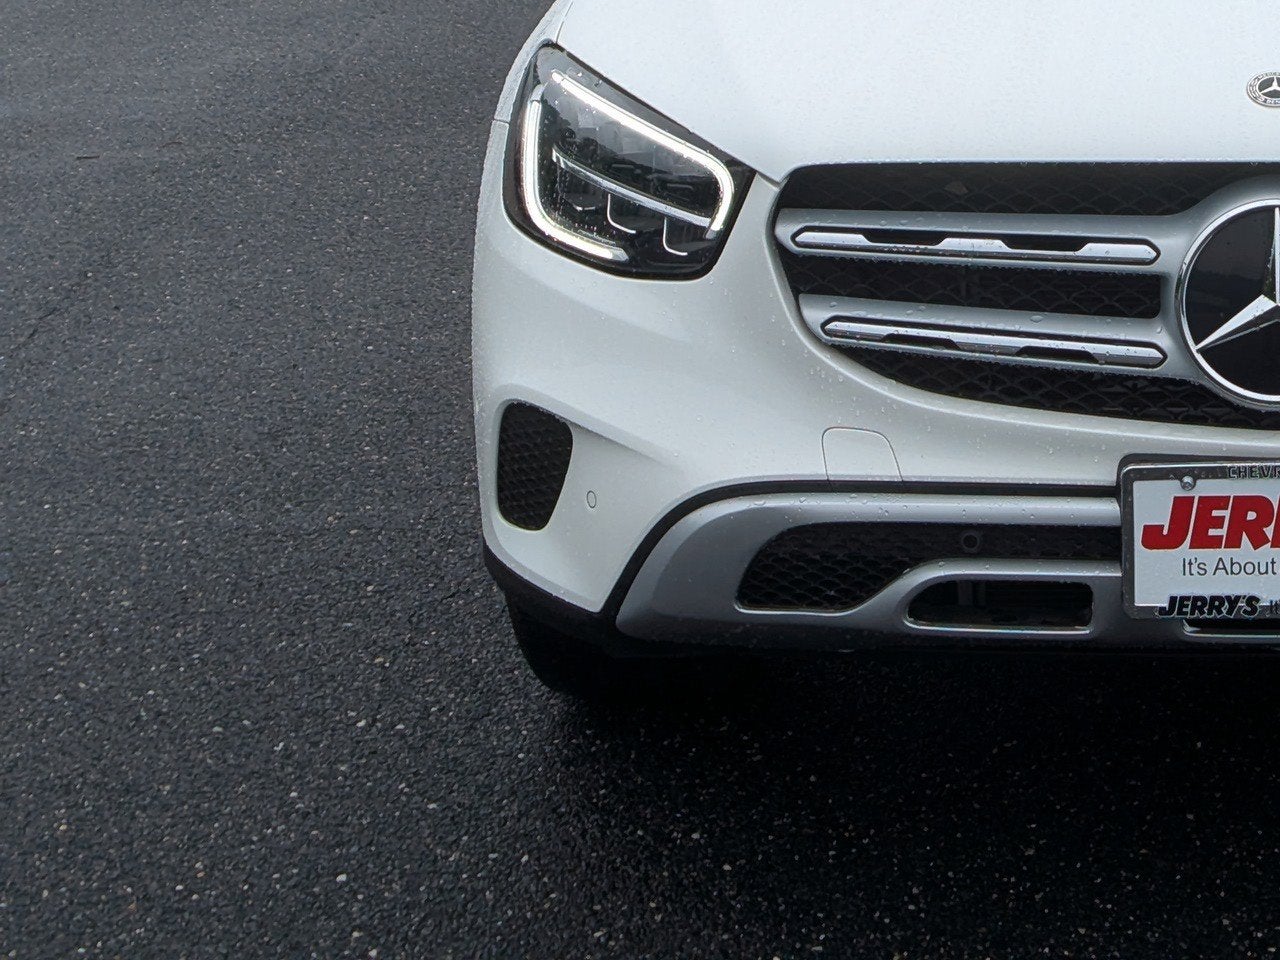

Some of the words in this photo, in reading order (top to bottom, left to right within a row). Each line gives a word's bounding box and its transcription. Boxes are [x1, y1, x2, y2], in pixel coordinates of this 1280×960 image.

[1181, 557, 1208, 577] It's
[1213, 556, 1277, 577] About
[1158, 594, 1262, 618] JERRY'S
